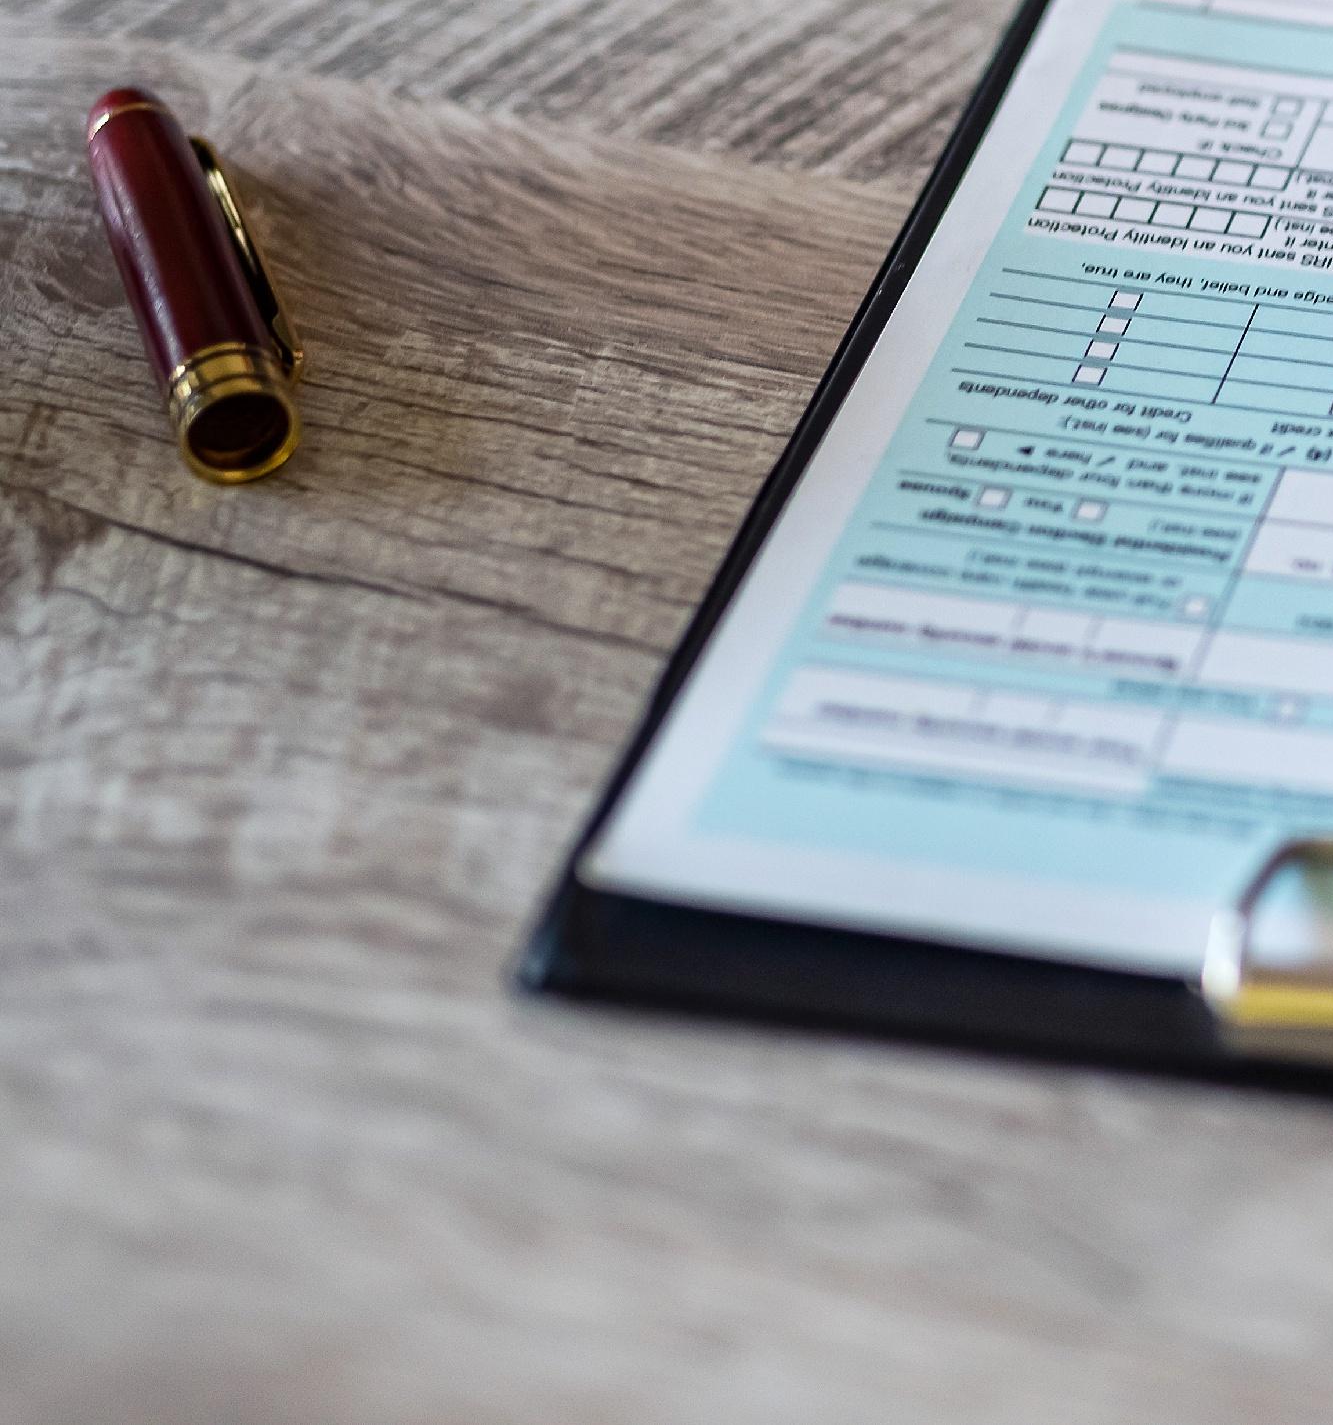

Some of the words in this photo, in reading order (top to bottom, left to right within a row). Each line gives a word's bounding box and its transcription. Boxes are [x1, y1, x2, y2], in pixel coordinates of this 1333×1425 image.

[1027, 216, 1120, 242] Protection
[1121, 227, 1190, 252] Identity
[1219, 242, 1254, 257] you
[1256, 247, 1297, 262] sent
[1299, 253, 1333, 270] IRS
[957, 380, 1060, 406] dependents
[1061, 395, 1109, 411] other
[1111, 402, 1138, 417] for
[1139, 405, 1193, 425] Credit
[1269, 421, 1323, 438] credit
